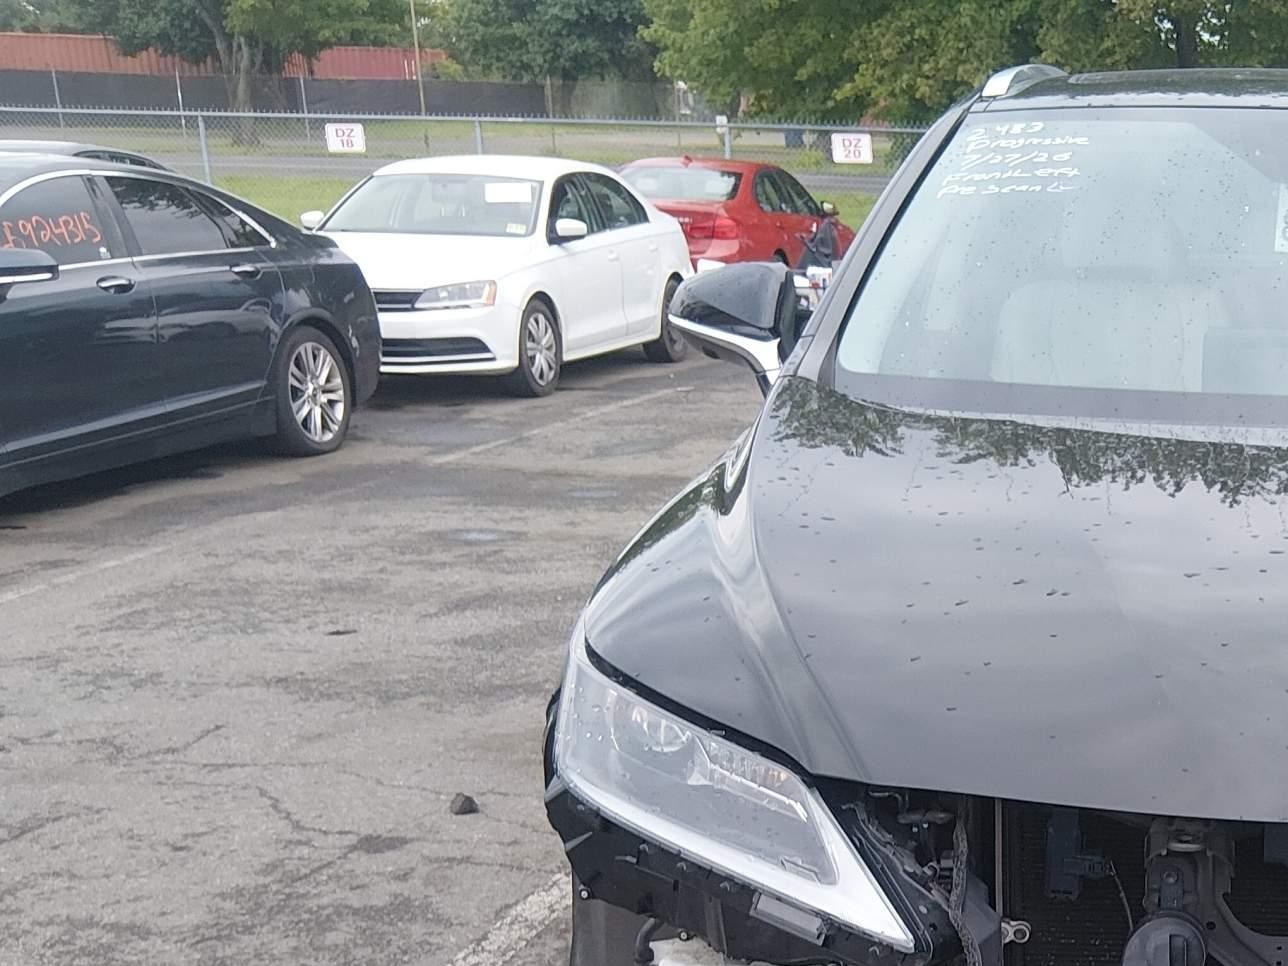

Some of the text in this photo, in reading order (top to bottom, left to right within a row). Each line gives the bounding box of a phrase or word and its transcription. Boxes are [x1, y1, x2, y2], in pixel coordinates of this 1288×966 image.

[335, 127, 356, 138] DZ
[339, 138, 354, 148] 18
[842, 137, 863, 148] DZ
[844, 148, 861, 159] 20
